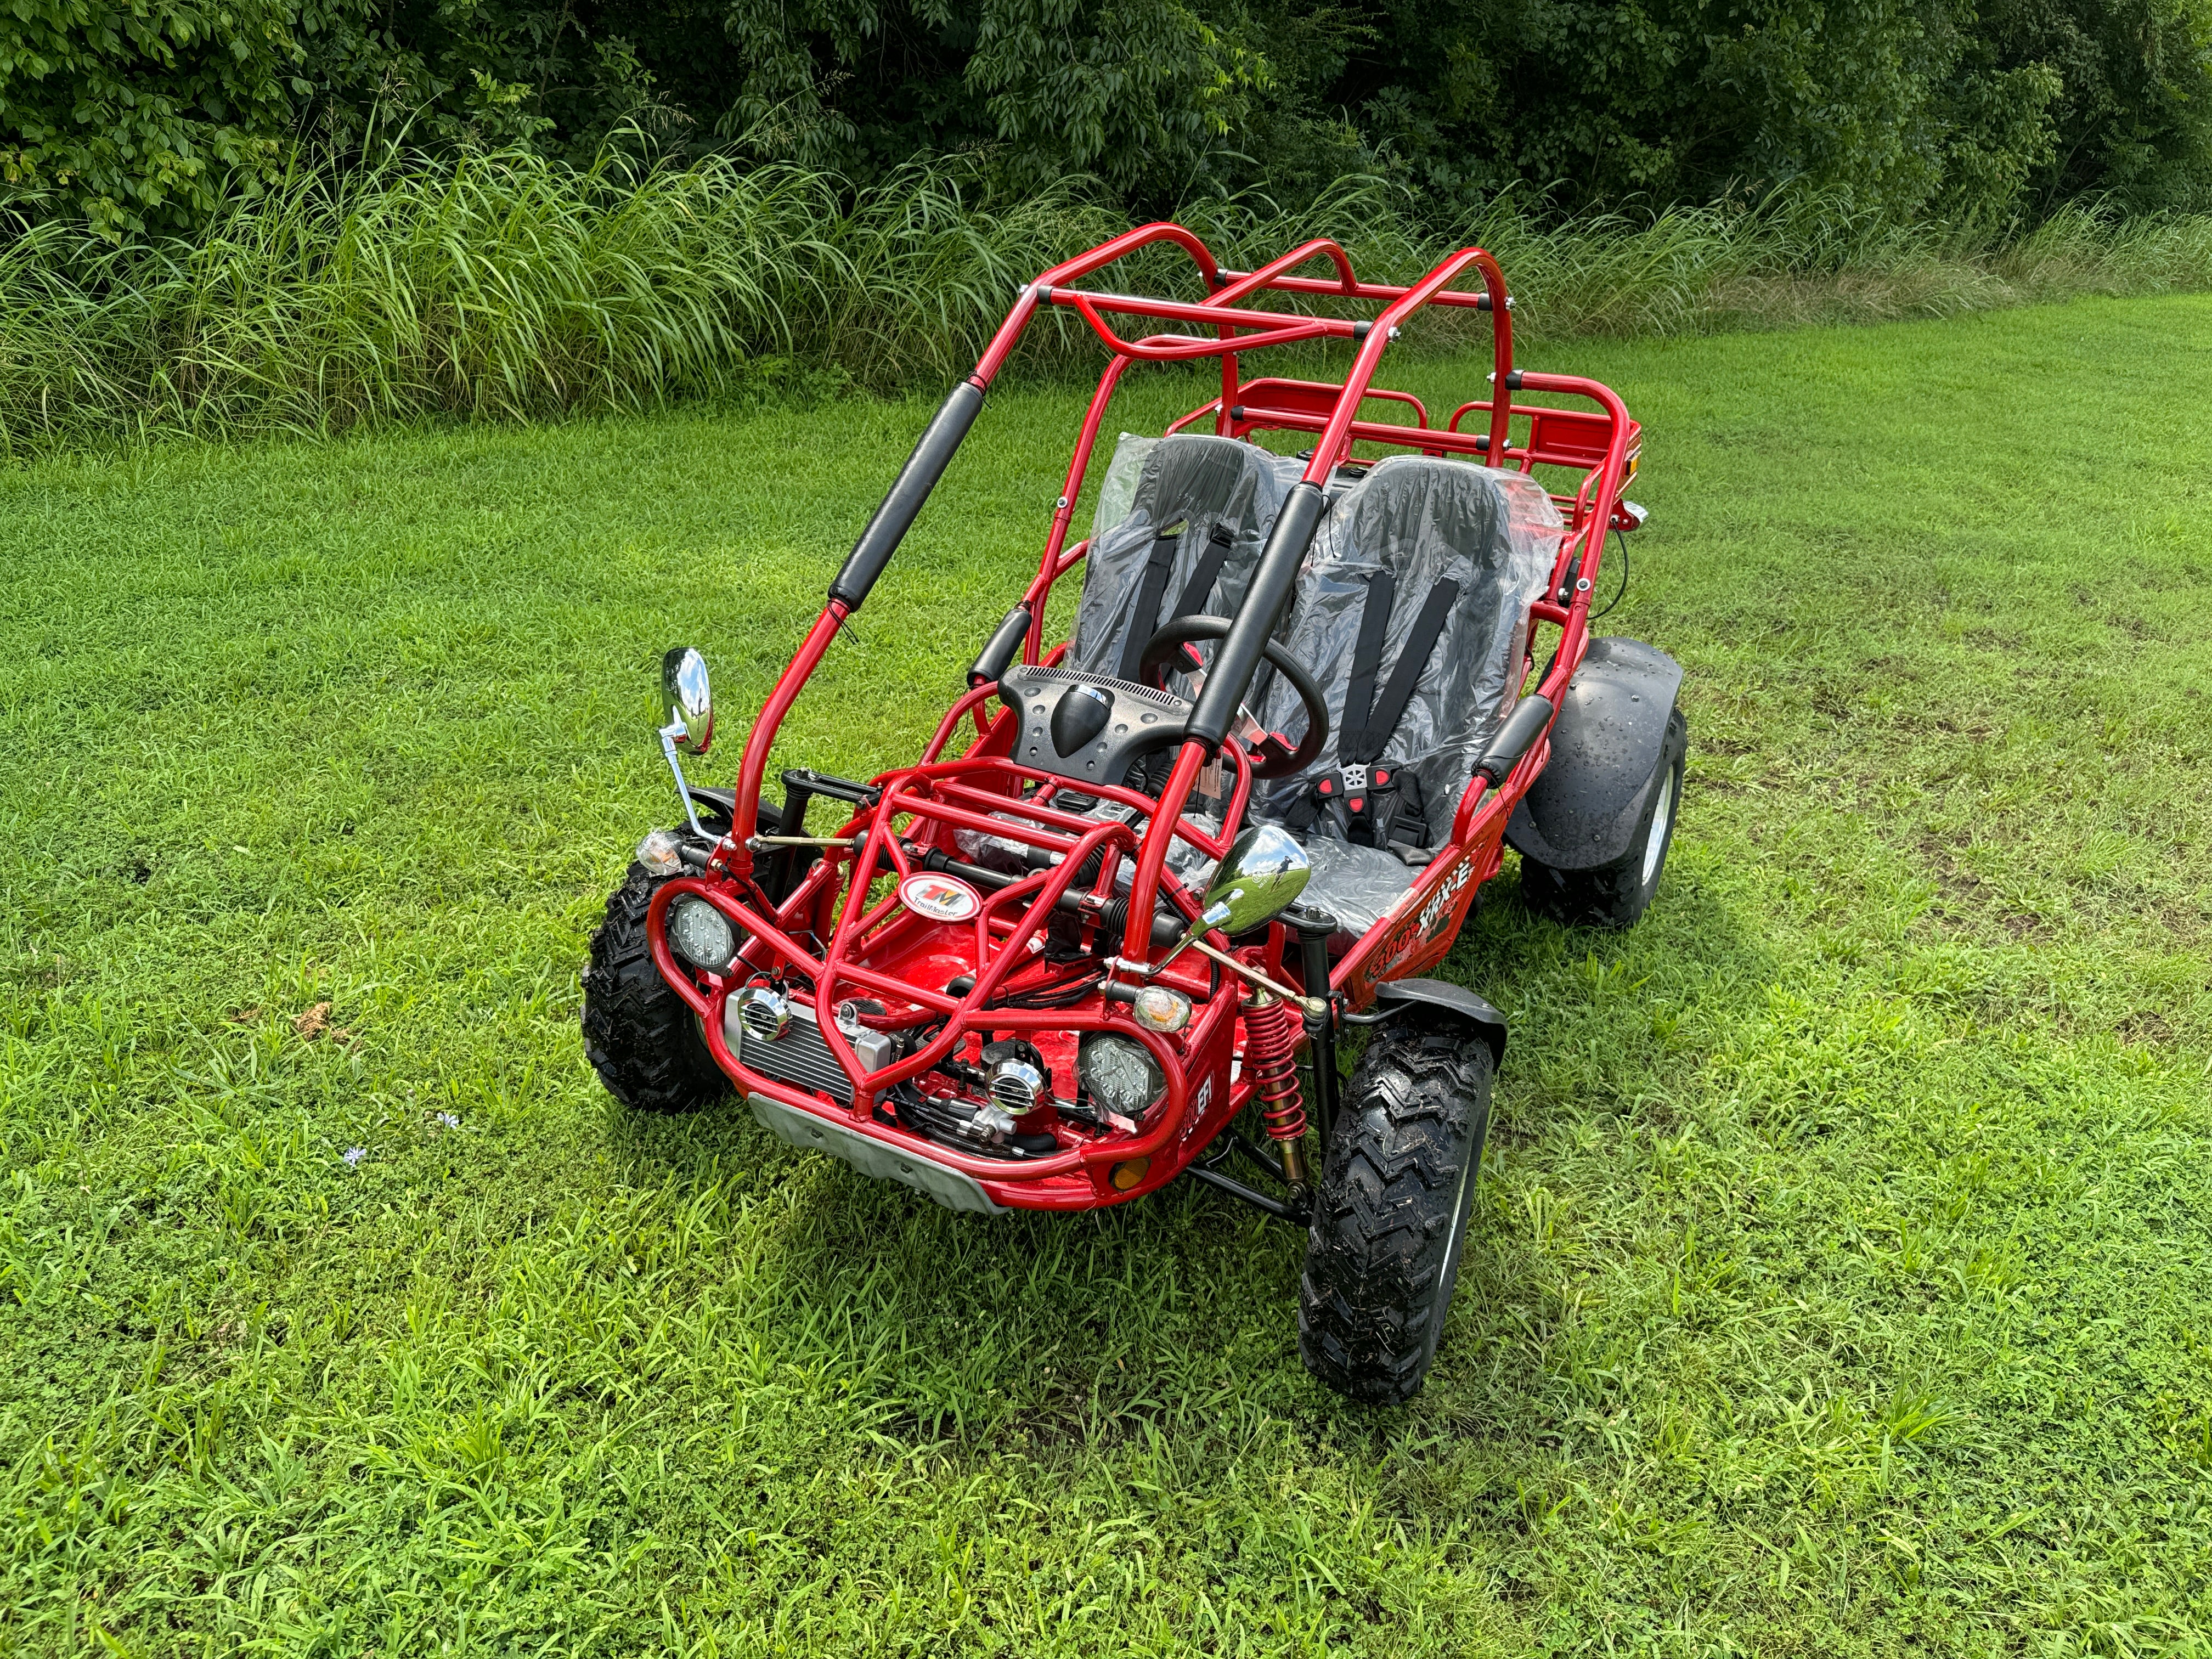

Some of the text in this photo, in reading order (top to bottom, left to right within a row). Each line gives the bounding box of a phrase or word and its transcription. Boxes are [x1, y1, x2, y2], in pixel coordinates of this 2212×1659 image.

[923, 885, 961, 906] TM
[914, 897, 958, 916] TrailMaster
[1373, 929, 1411, 975] 300
